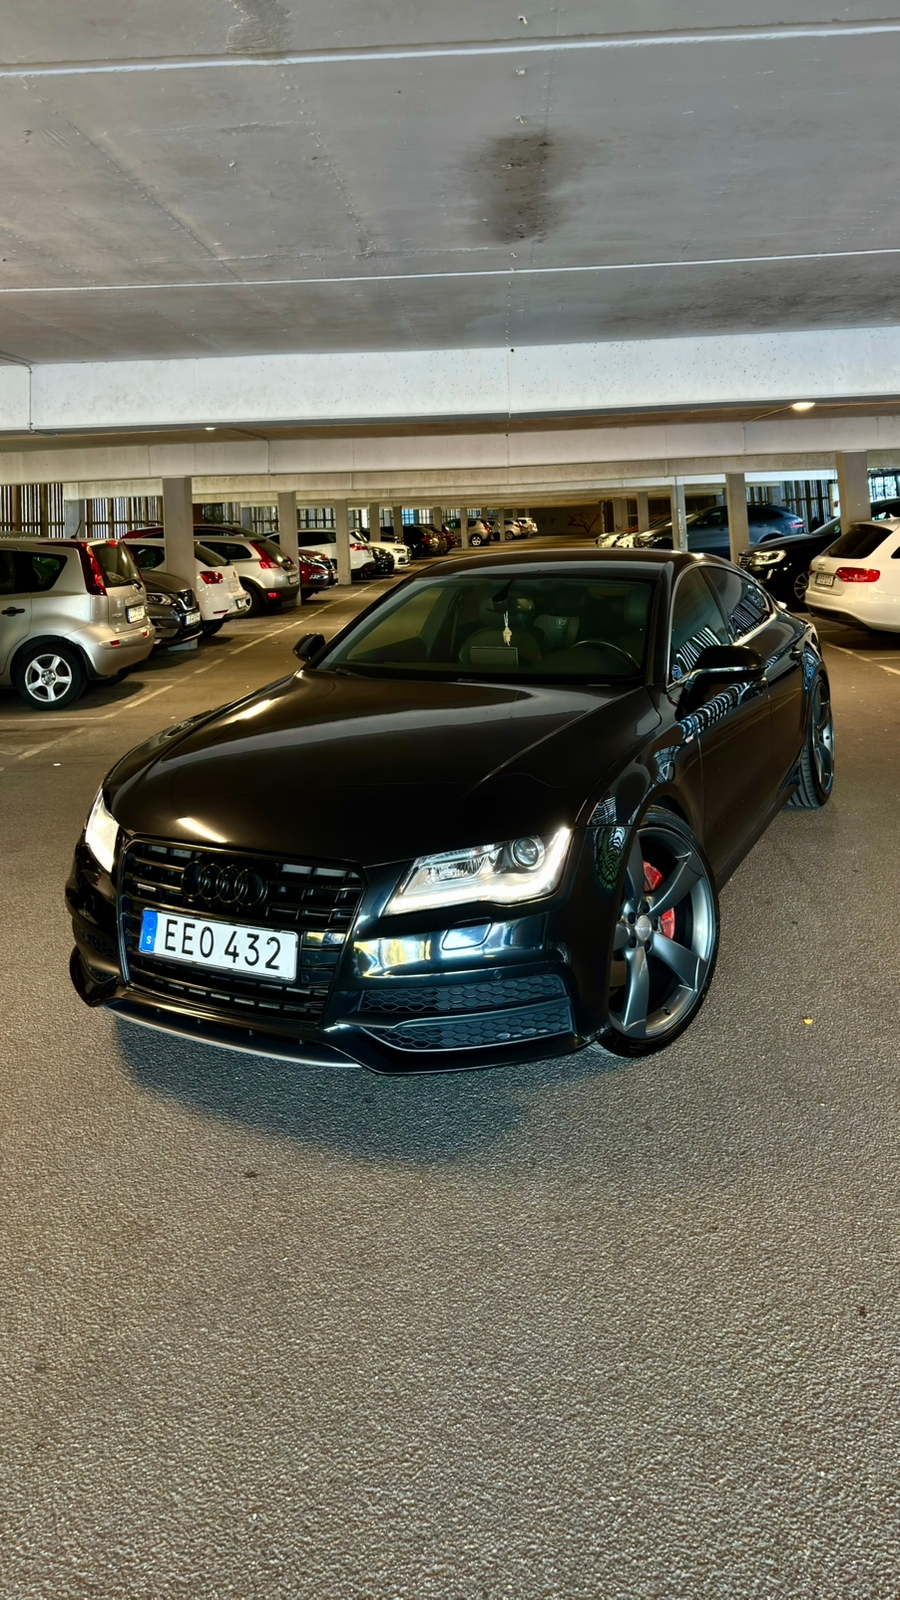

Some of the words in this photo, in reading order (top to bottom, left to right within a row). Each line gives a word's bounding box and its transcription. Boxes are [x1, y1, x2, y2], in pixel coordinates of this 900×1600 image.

[146, 935, 152, 945] S
[164, 918, 214, 958] EEO
[224, 930, 281, 970] 432
